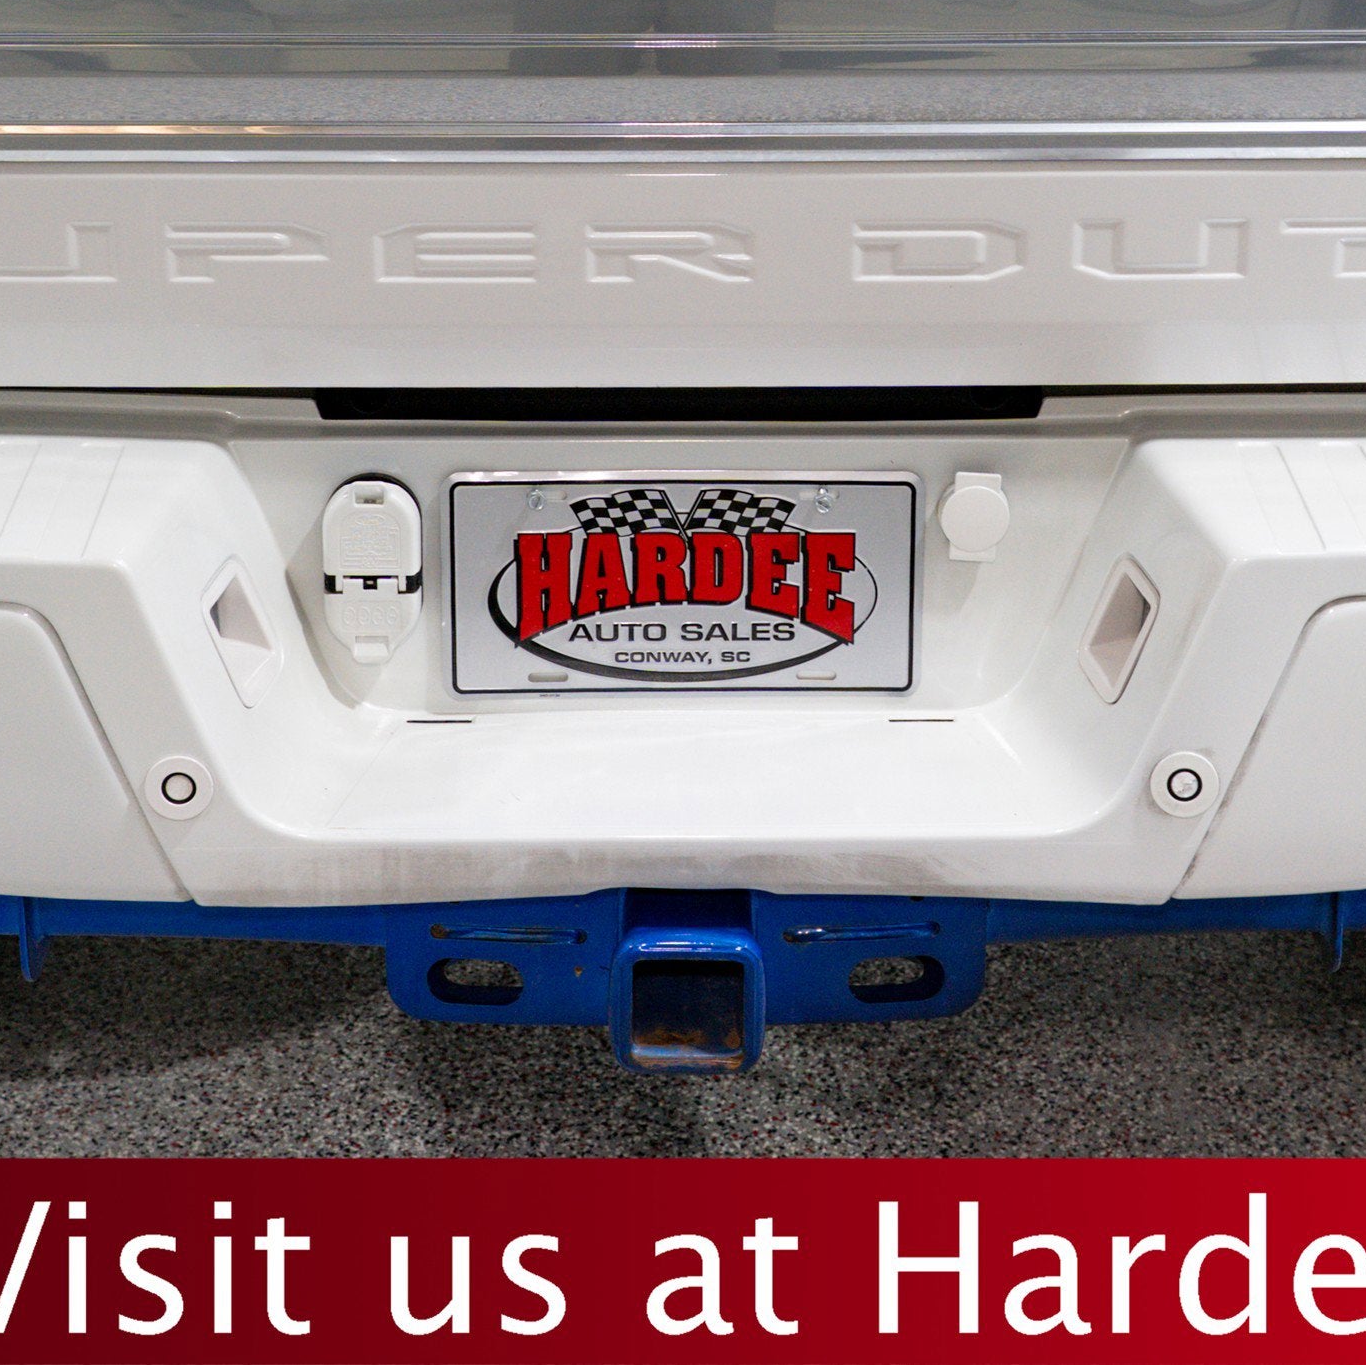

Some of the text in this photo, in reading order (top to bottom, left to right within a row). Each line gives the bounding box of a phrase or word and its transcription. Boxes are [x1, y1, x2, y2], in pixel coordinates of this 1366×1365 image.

[514, 532, 856, 647] HARDEE
[568, 621, 796, 642] AUTO SALES
[614, 650, 752, 665] CONWAY, SC
